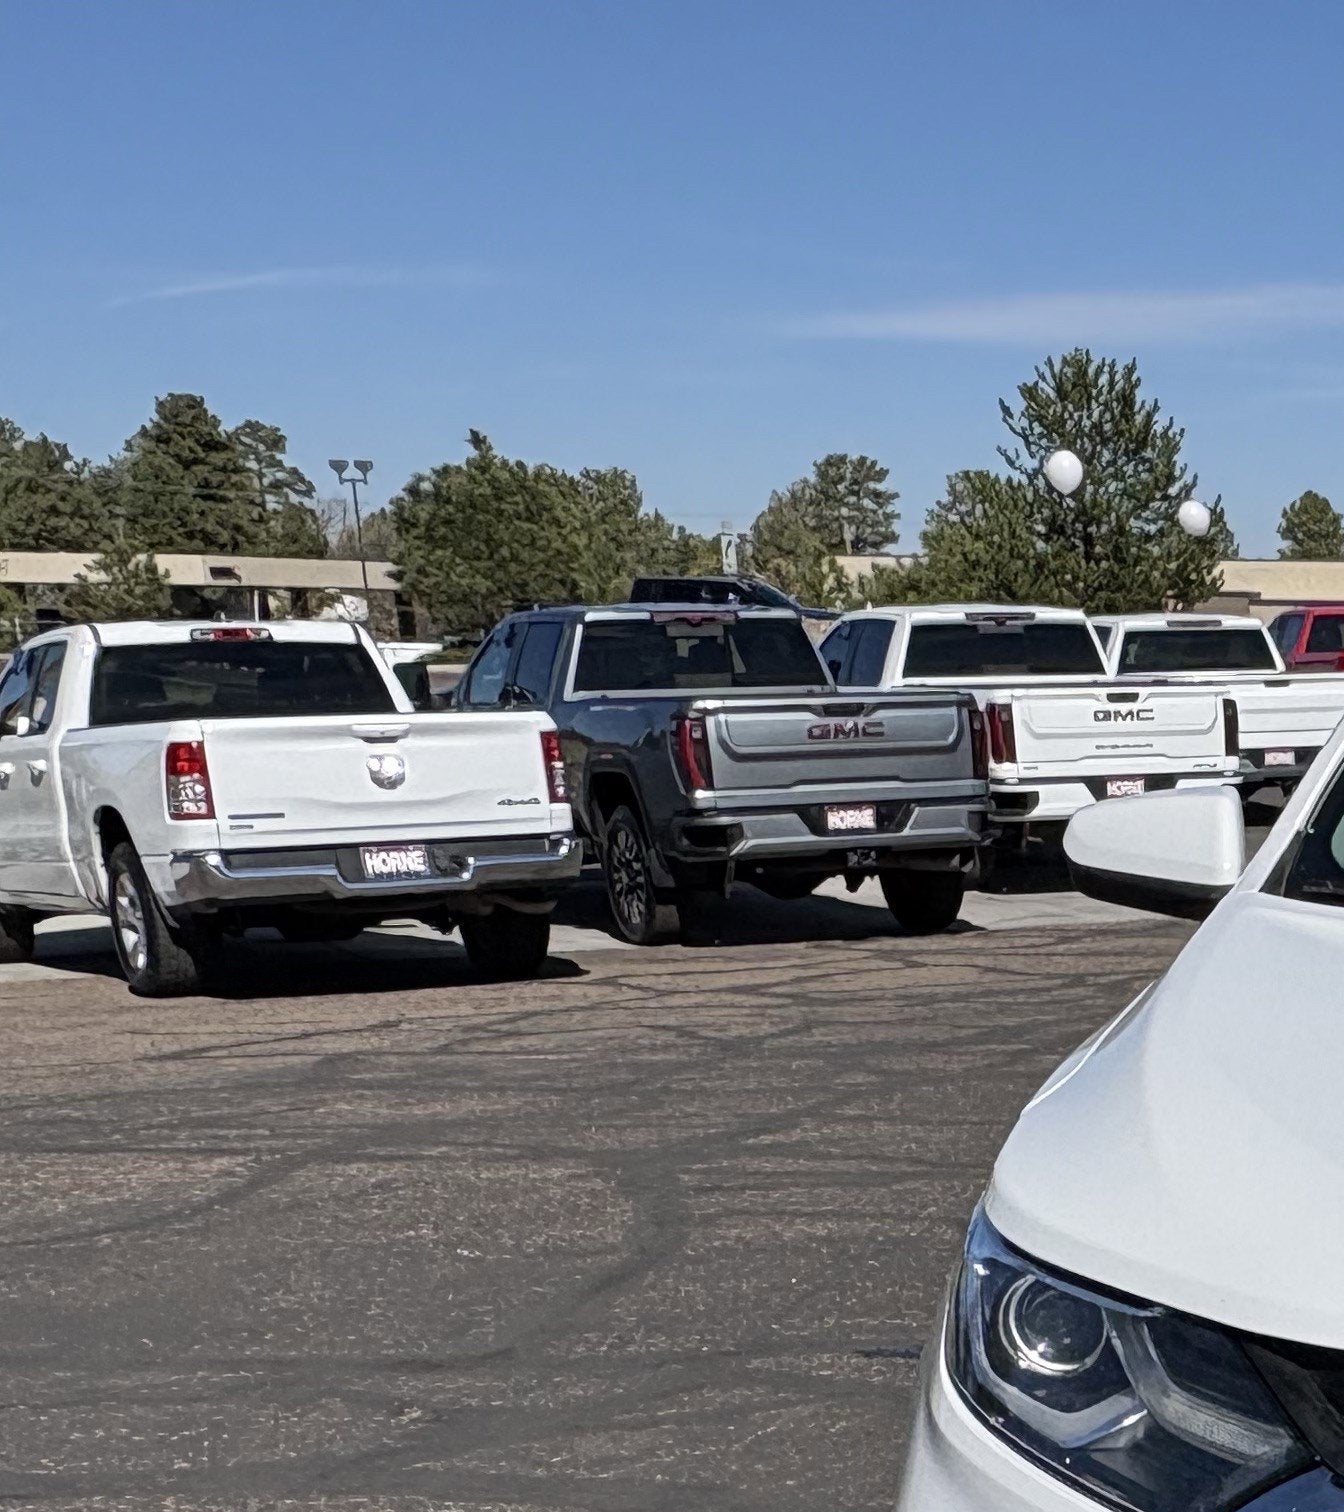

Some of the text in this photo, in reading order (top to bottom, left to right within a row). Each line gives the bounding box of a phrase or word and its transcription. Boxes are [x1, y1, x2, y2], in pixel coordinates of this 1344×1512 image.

[1093, 708, 1155, 722] GMC
[806, 721, 885, 740] GMC
[364, 850, 426, 875] HORNE
